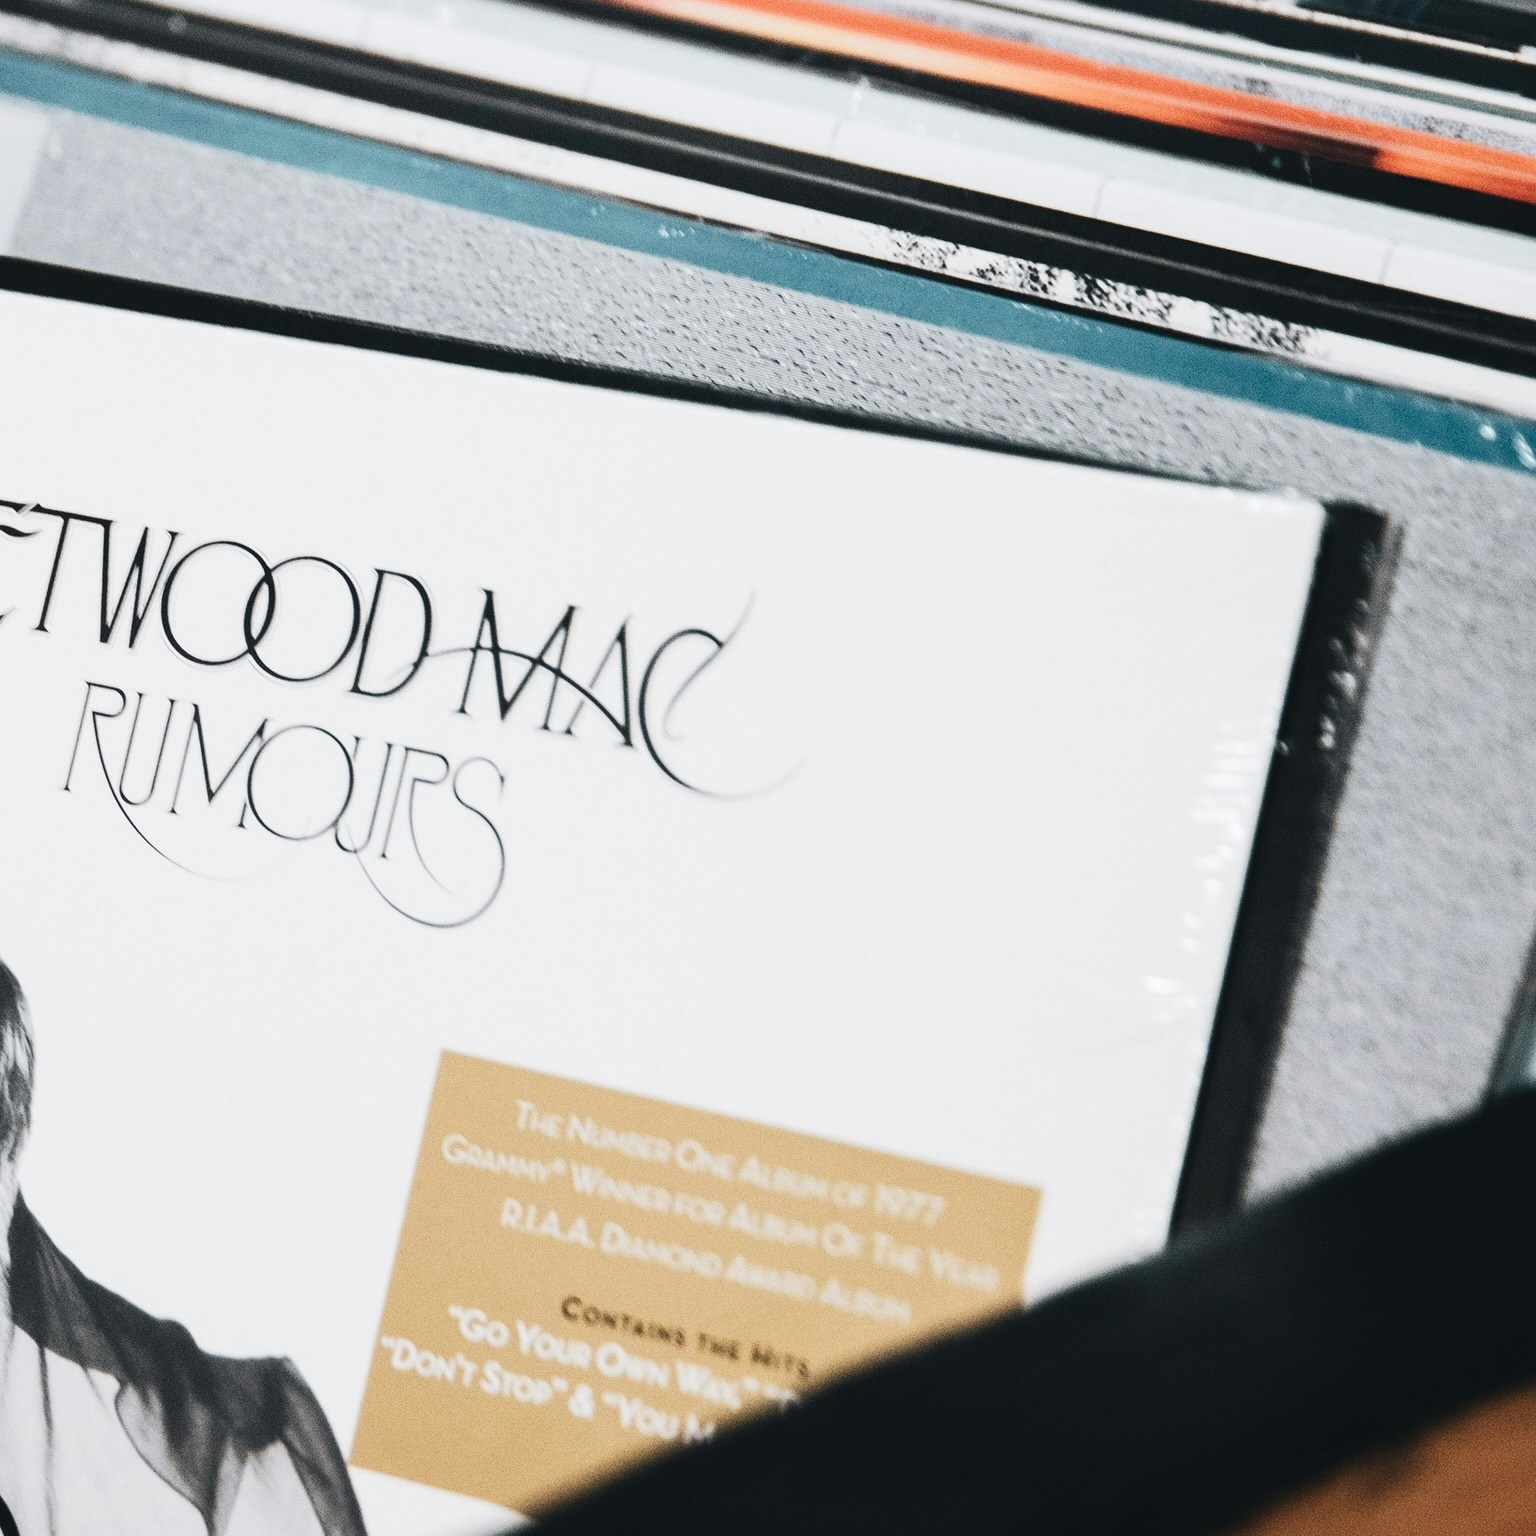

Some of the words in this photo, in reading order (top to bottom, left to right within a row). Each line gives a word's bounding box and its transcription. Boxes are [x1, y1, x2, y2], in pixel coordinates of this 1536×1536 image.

[452, 588, 799, 798] MAC
[62, 681, 506, 929] RUMOURS
[516, 1099, 563, 1141] THE
[515, 1320, 592, 1369] YOUR
[595, 1341, 670, 1389] OWN
[561, 1295, 685, 1349] CONTAINS
[697, 1330, 741, 1361] THE
[567, 1383, 596, 1421] &
